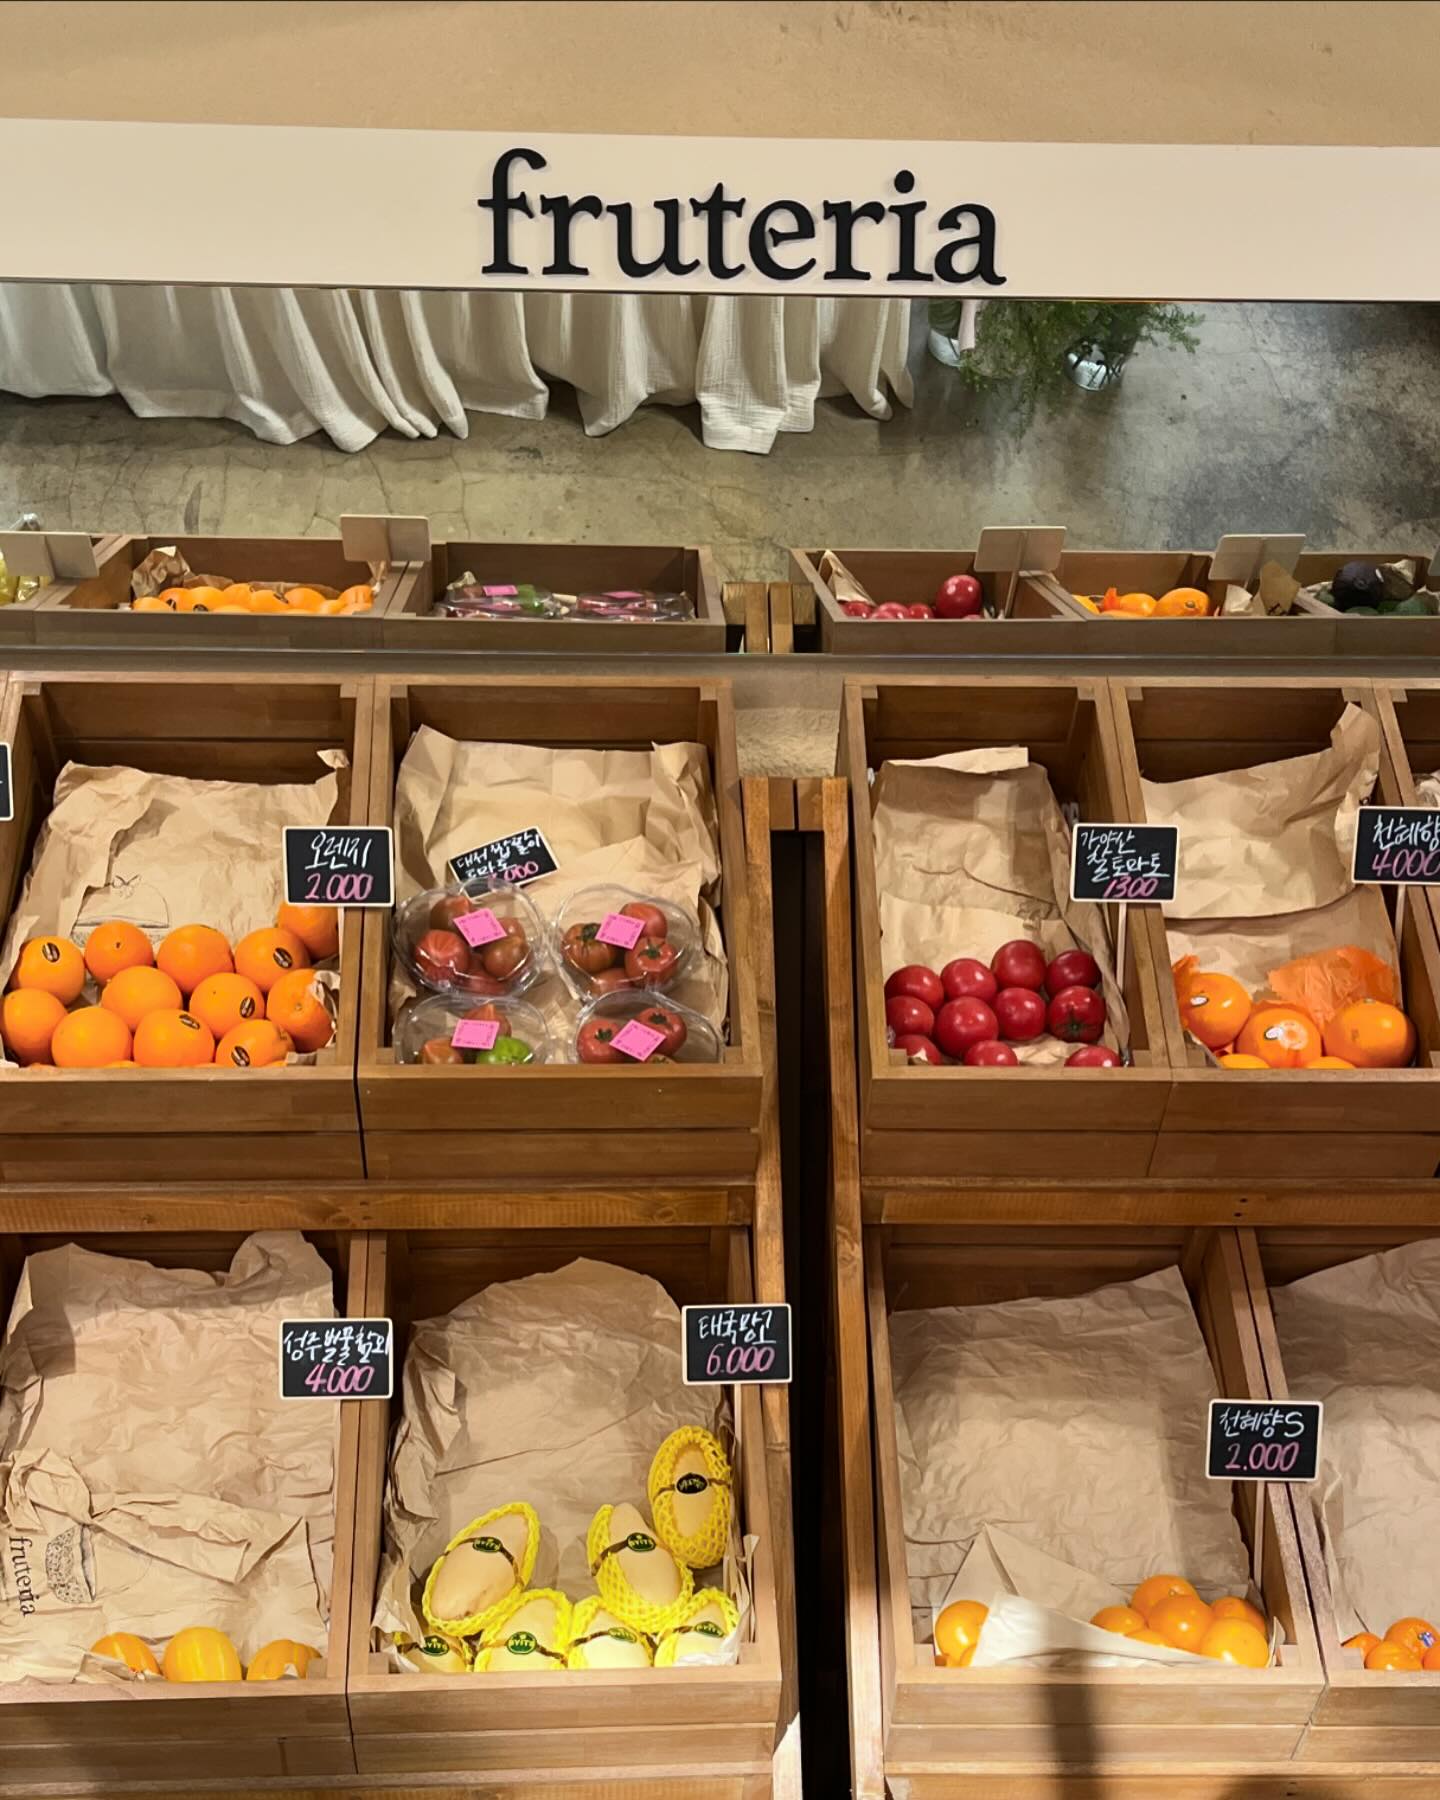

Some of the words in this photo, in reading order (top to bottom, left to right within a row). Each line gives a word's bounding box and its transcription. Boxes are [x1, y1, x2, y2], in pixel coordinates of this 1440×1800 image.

[478, 147, 1007, 285] fruteria
[304, 831, 372, 870] 오렌지
[1080, 829, 1136, 854] 가야산
[1103, 876, 1160, 898] 1300
[706, 1343, 776, 1376] 6.000
[1225, 1441, 1300, 1472] 2.000
[9, 1535, 40, 1618] fruteria
